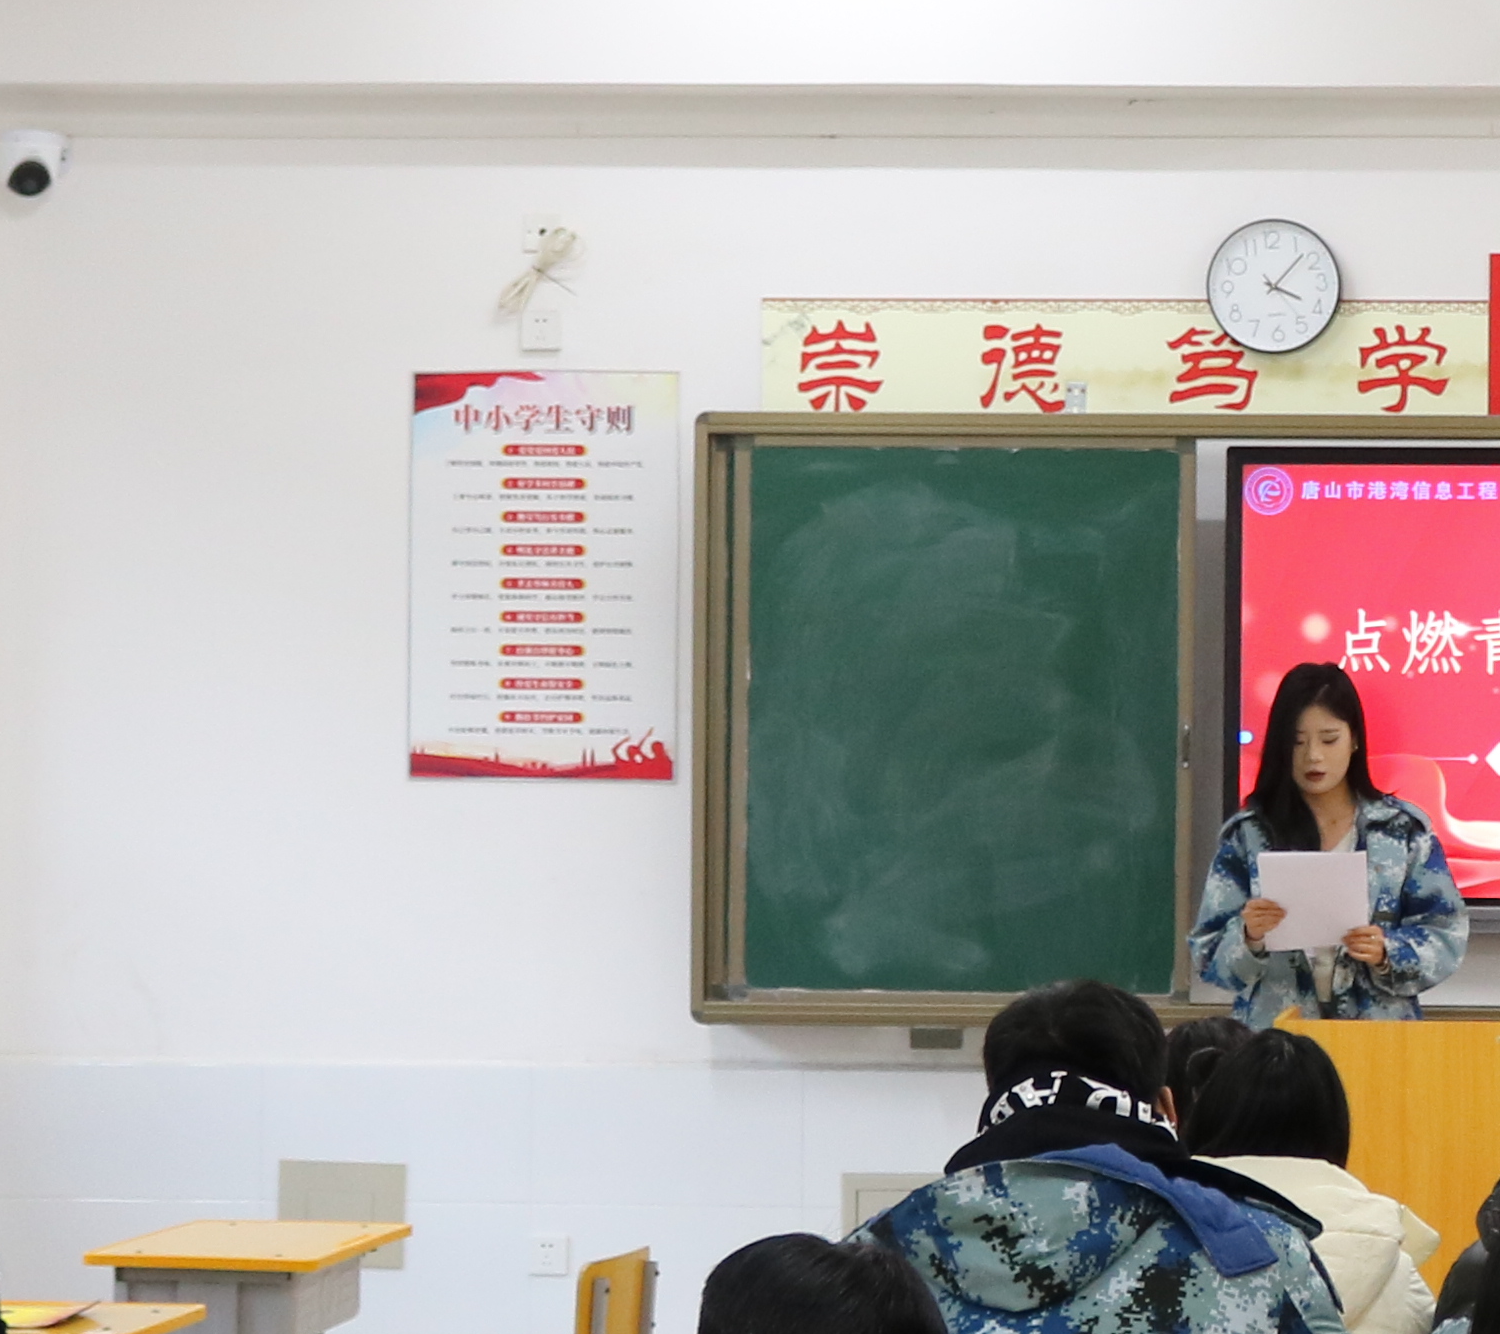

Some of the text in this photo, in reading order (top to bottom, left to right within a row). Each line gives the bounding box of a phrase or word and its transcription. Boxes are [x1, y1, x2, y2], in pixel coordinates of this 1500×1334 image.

[1244, 238, 1257, 256] 11
[1263, 230, 1280, 250] 12
[1226, 257, 1248, 276] 10
[1306, 251, 1321, 271] 2
[1221, 280, 1234, 298] 9
[1315, 273, 1329, 292] 3
[1229, 303, 1242, 323] 8
[1311, 298, 1322, 315] 4
[1248, 319, 1260, 338] 7
[1272, 324, 1285, 343] 6
[1295, 315, 1309, 334] 5
[797, 319, 1451, 414] 崇德笃学
[453, 404, 635, 434] 中小学生守则
